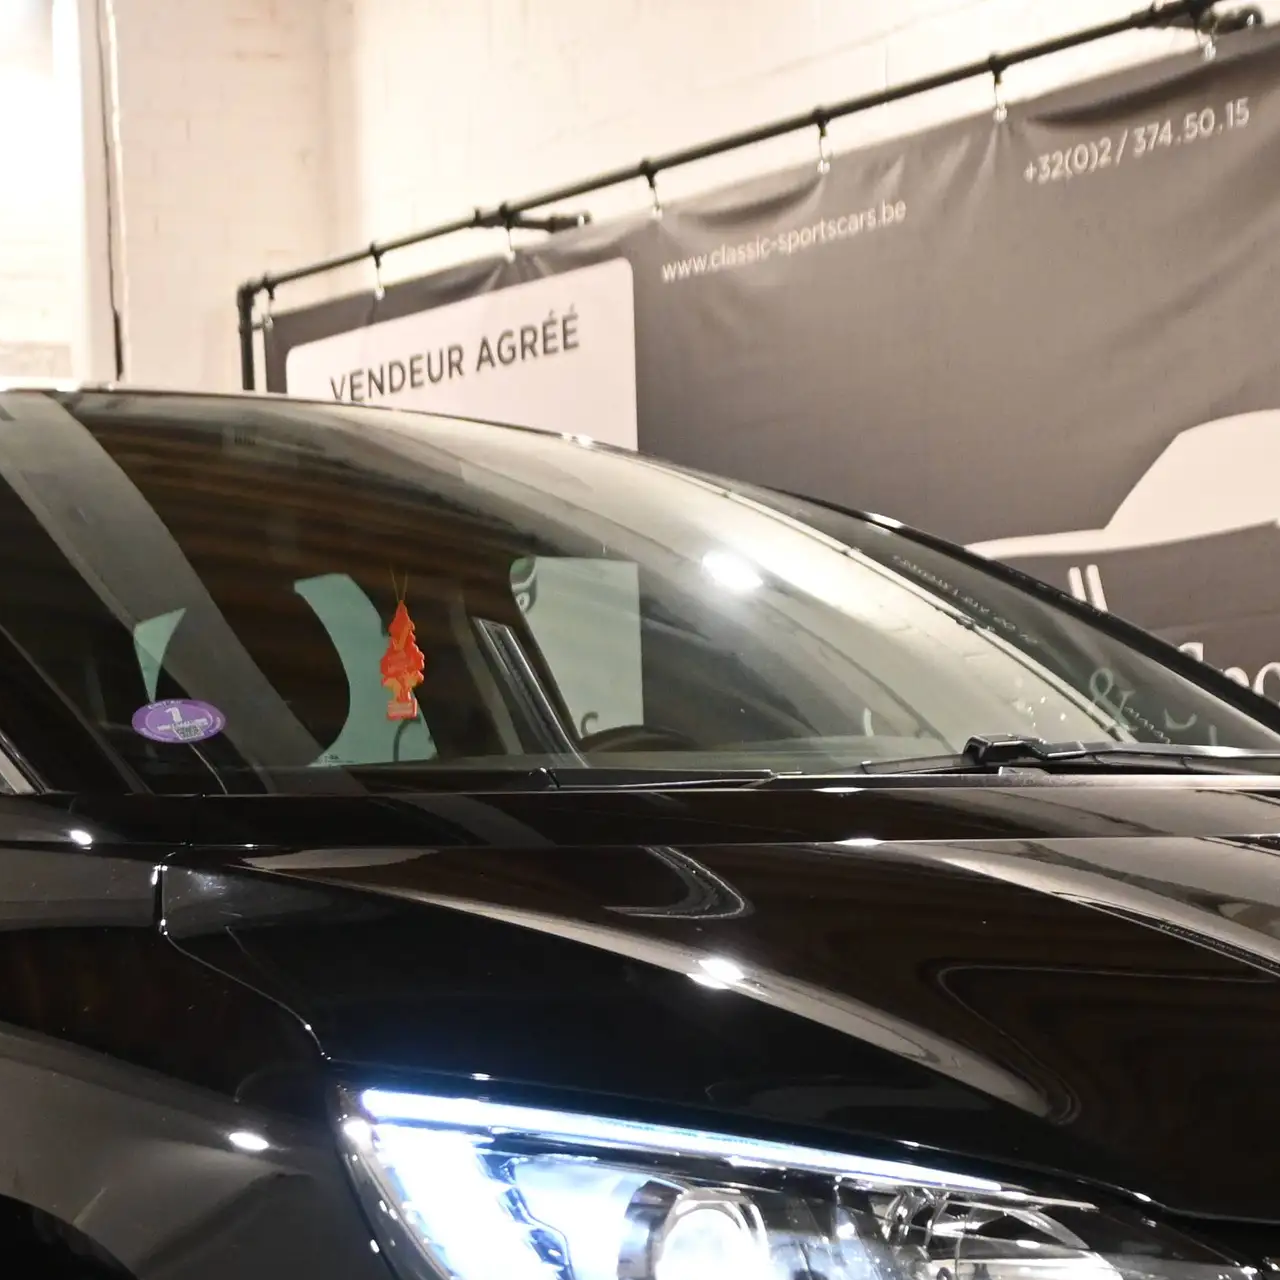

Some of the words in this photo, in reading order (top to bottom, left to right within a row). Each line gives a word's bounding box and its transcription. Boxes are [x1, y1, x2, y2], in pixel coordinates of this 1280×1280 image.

[1024, 136, 1112, 184] +32(0)2
[661, 200, 907, 283] www.classic-sportscars.be
[330, 344, 464, 402] VENDEUR
[476, 303, 580, 372] AGRÉÉ
